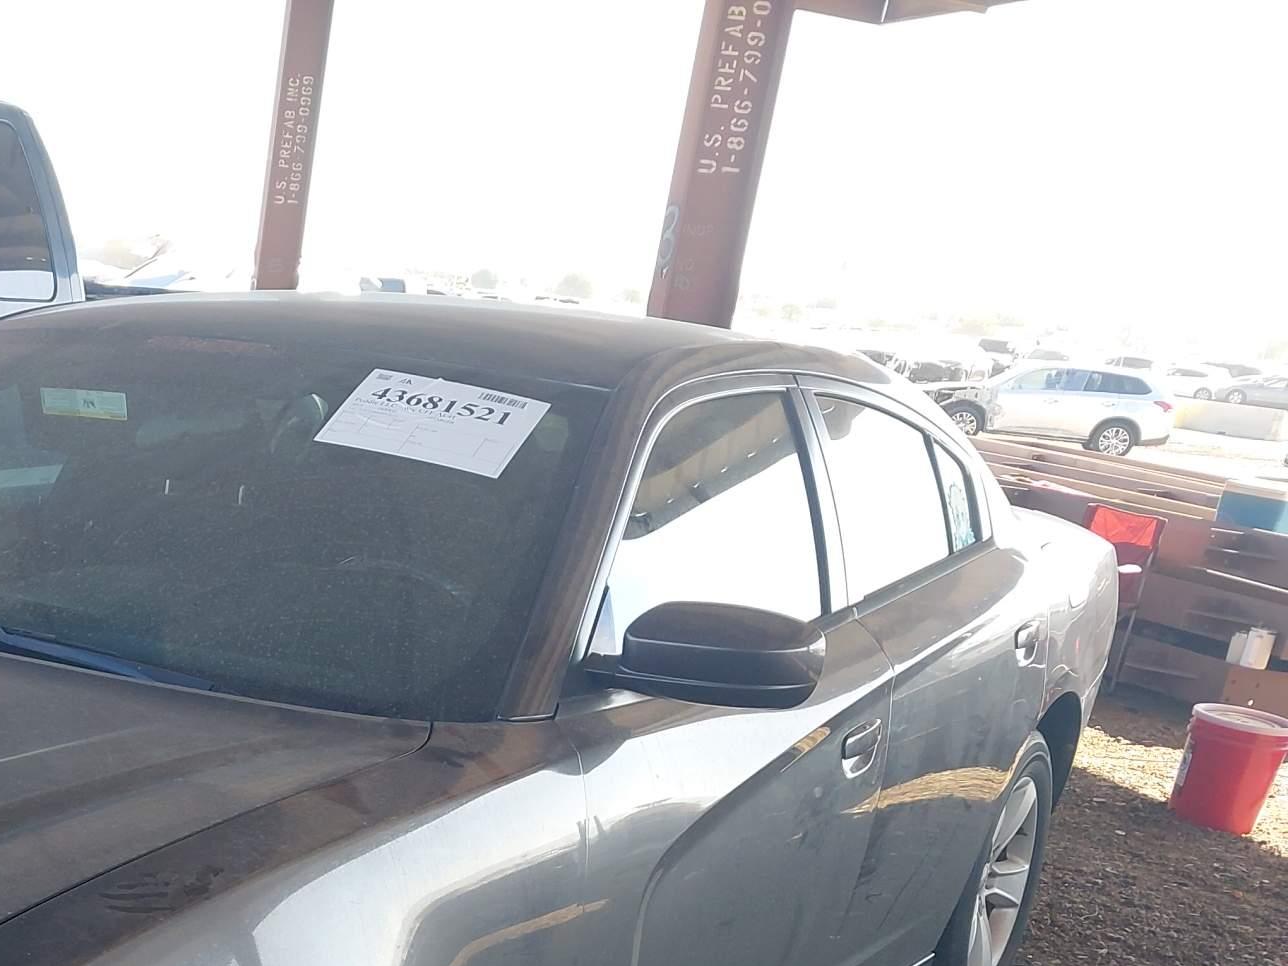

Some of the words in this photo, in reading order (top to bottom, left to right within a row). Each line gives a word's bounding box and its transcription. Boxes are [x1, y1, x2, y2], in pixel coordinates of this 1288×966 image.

[710, 6, 747, 109] PREFAB
[278, 110, 296, 169] PREFAB
[697, 126, 725, 173] U.S.
[370, 386, 512, 426] 43681521
